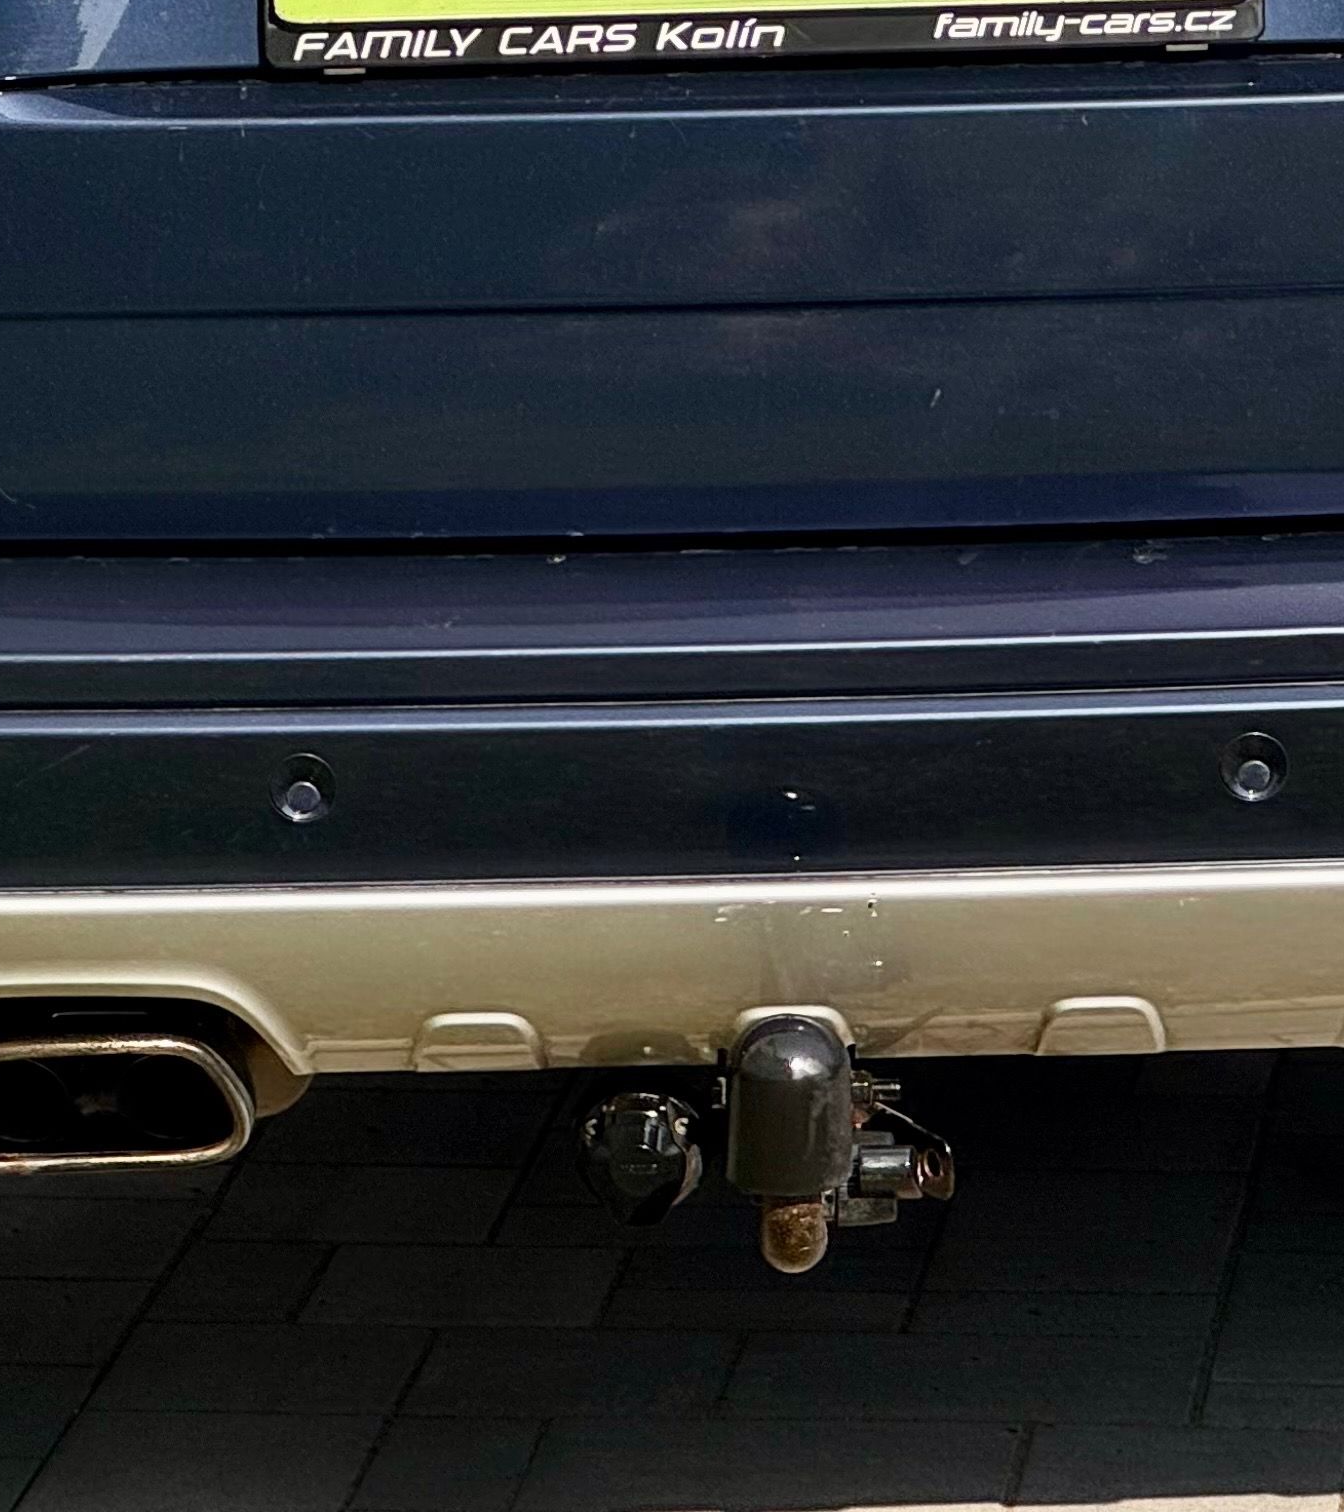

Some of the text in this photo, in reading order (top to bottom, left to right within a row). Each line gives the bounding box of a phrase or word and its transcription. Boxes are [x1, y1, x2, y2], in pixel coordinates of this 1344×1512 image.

[293, 18, 787, 62] FAMILY CARS Kolín
[933, 10, 1238, 42] family-cars.cz
